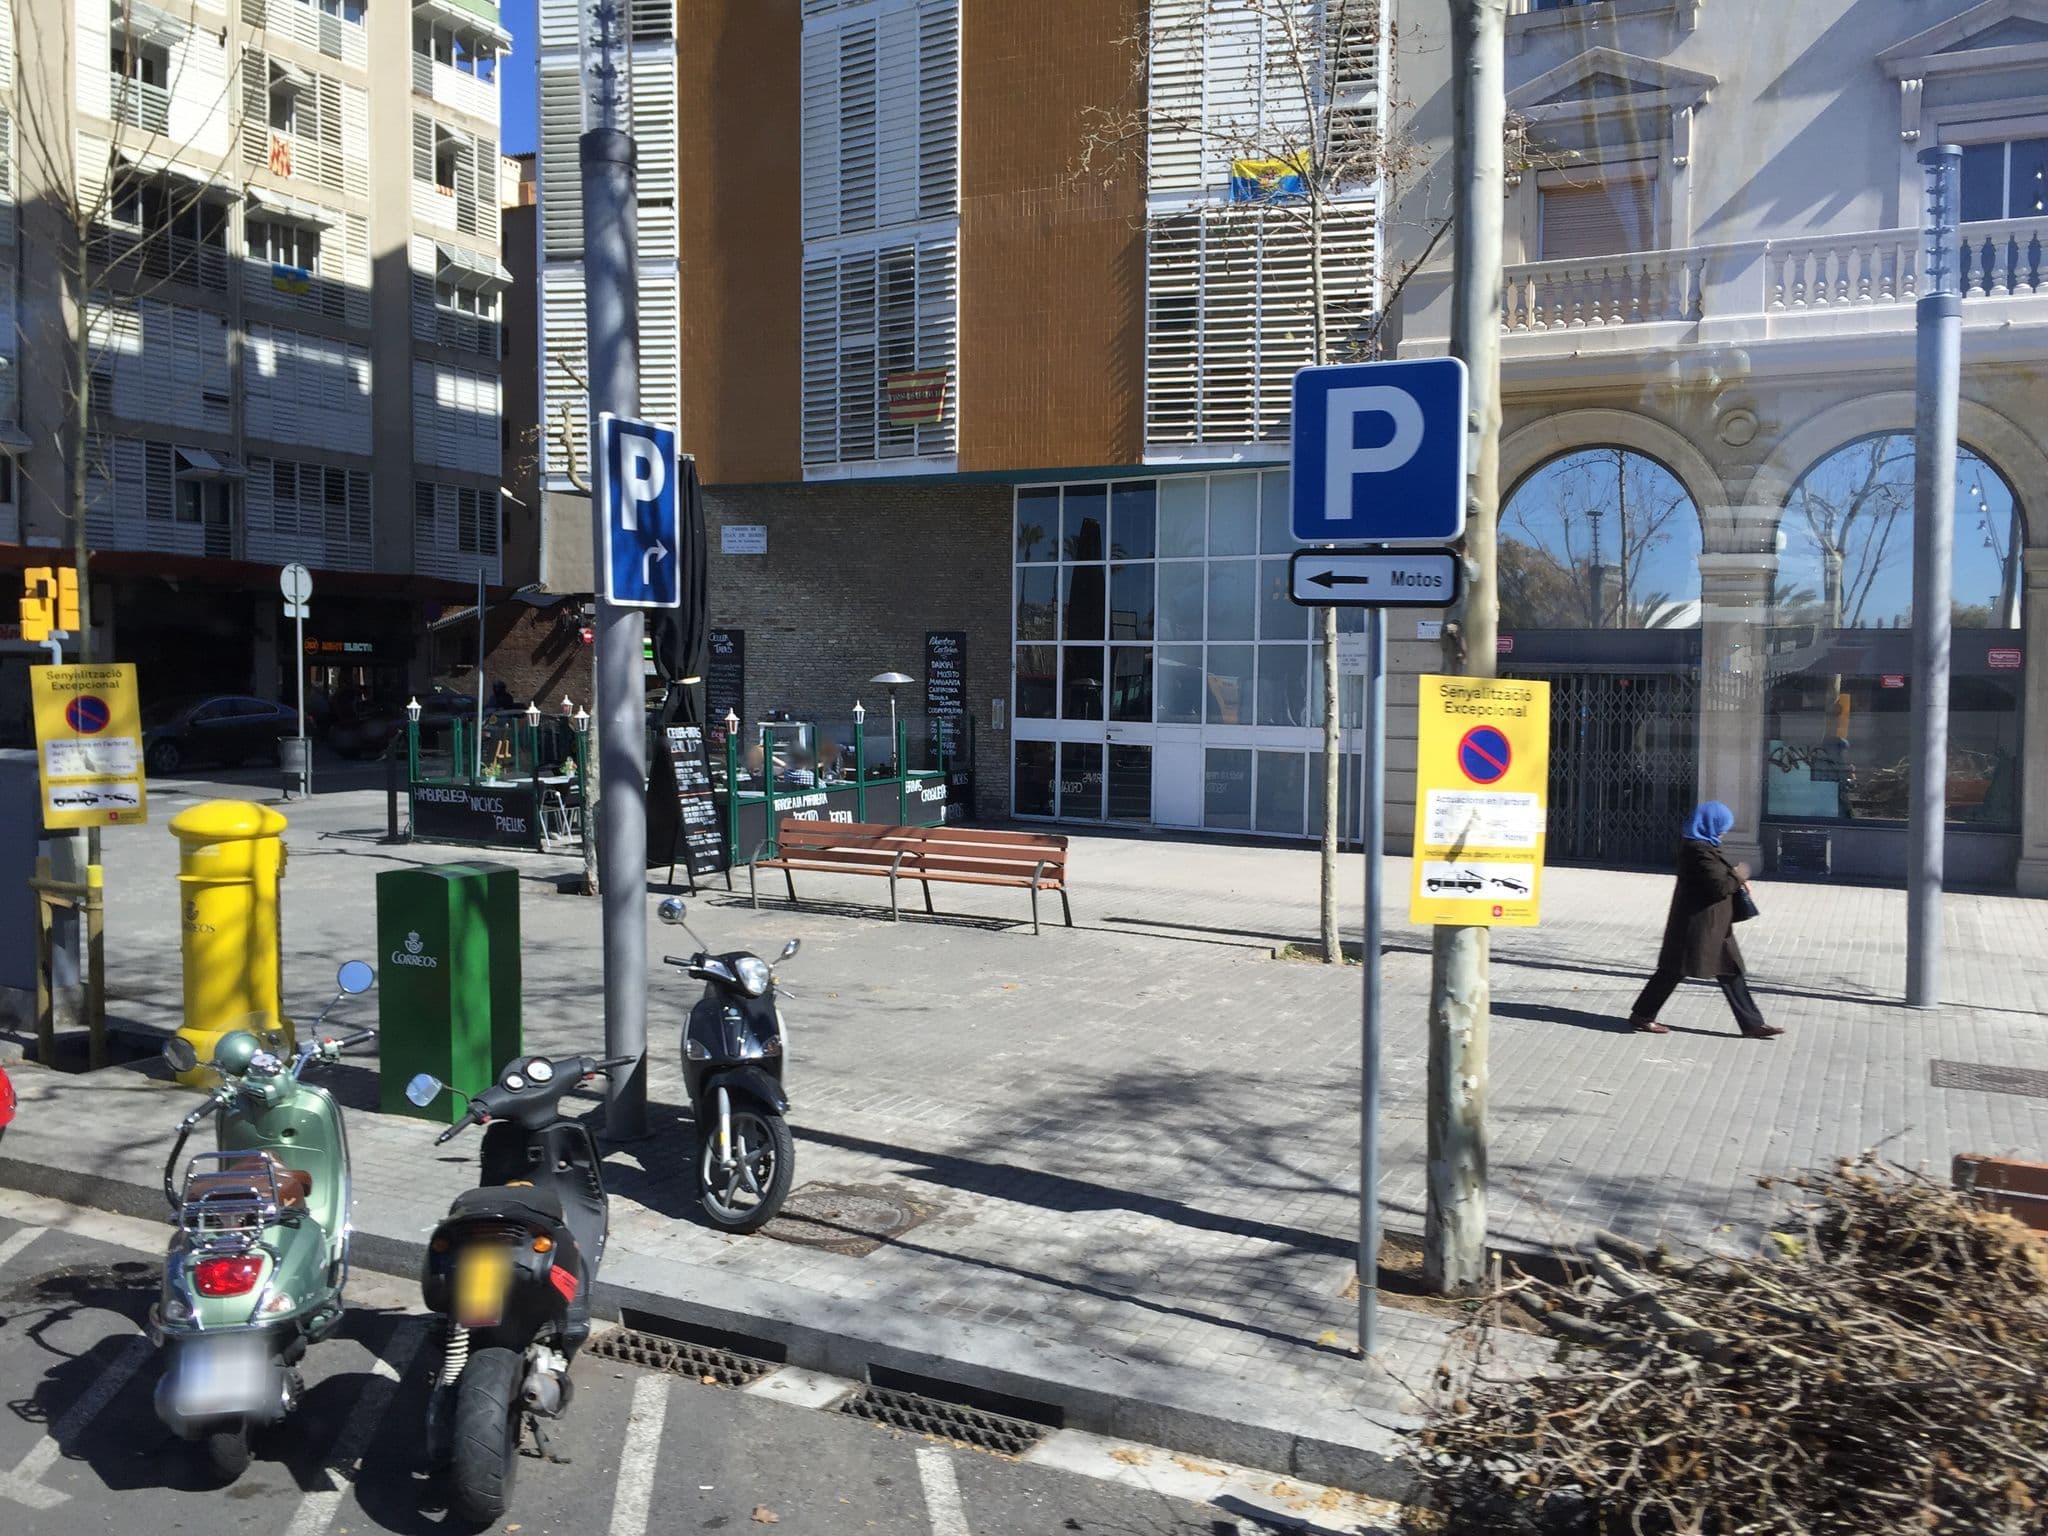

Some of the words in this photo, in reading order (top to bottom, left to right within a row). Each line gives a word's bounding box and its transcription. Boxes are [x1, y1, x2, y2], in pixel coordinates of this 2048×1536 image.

[1324, 385, 1425, 520] P
[620, 432, 665, 531] P
[1391, 570, 1443, 588] Motos
[46, 669, 122, 681] Senyalització
[51, 680, 120, 691] Excepcional
[1440, 684, 1533, 703] Senyalització
[1444, 701, 1528, 718] Excepcional
[391, 951, 438, 968] CORREOS
